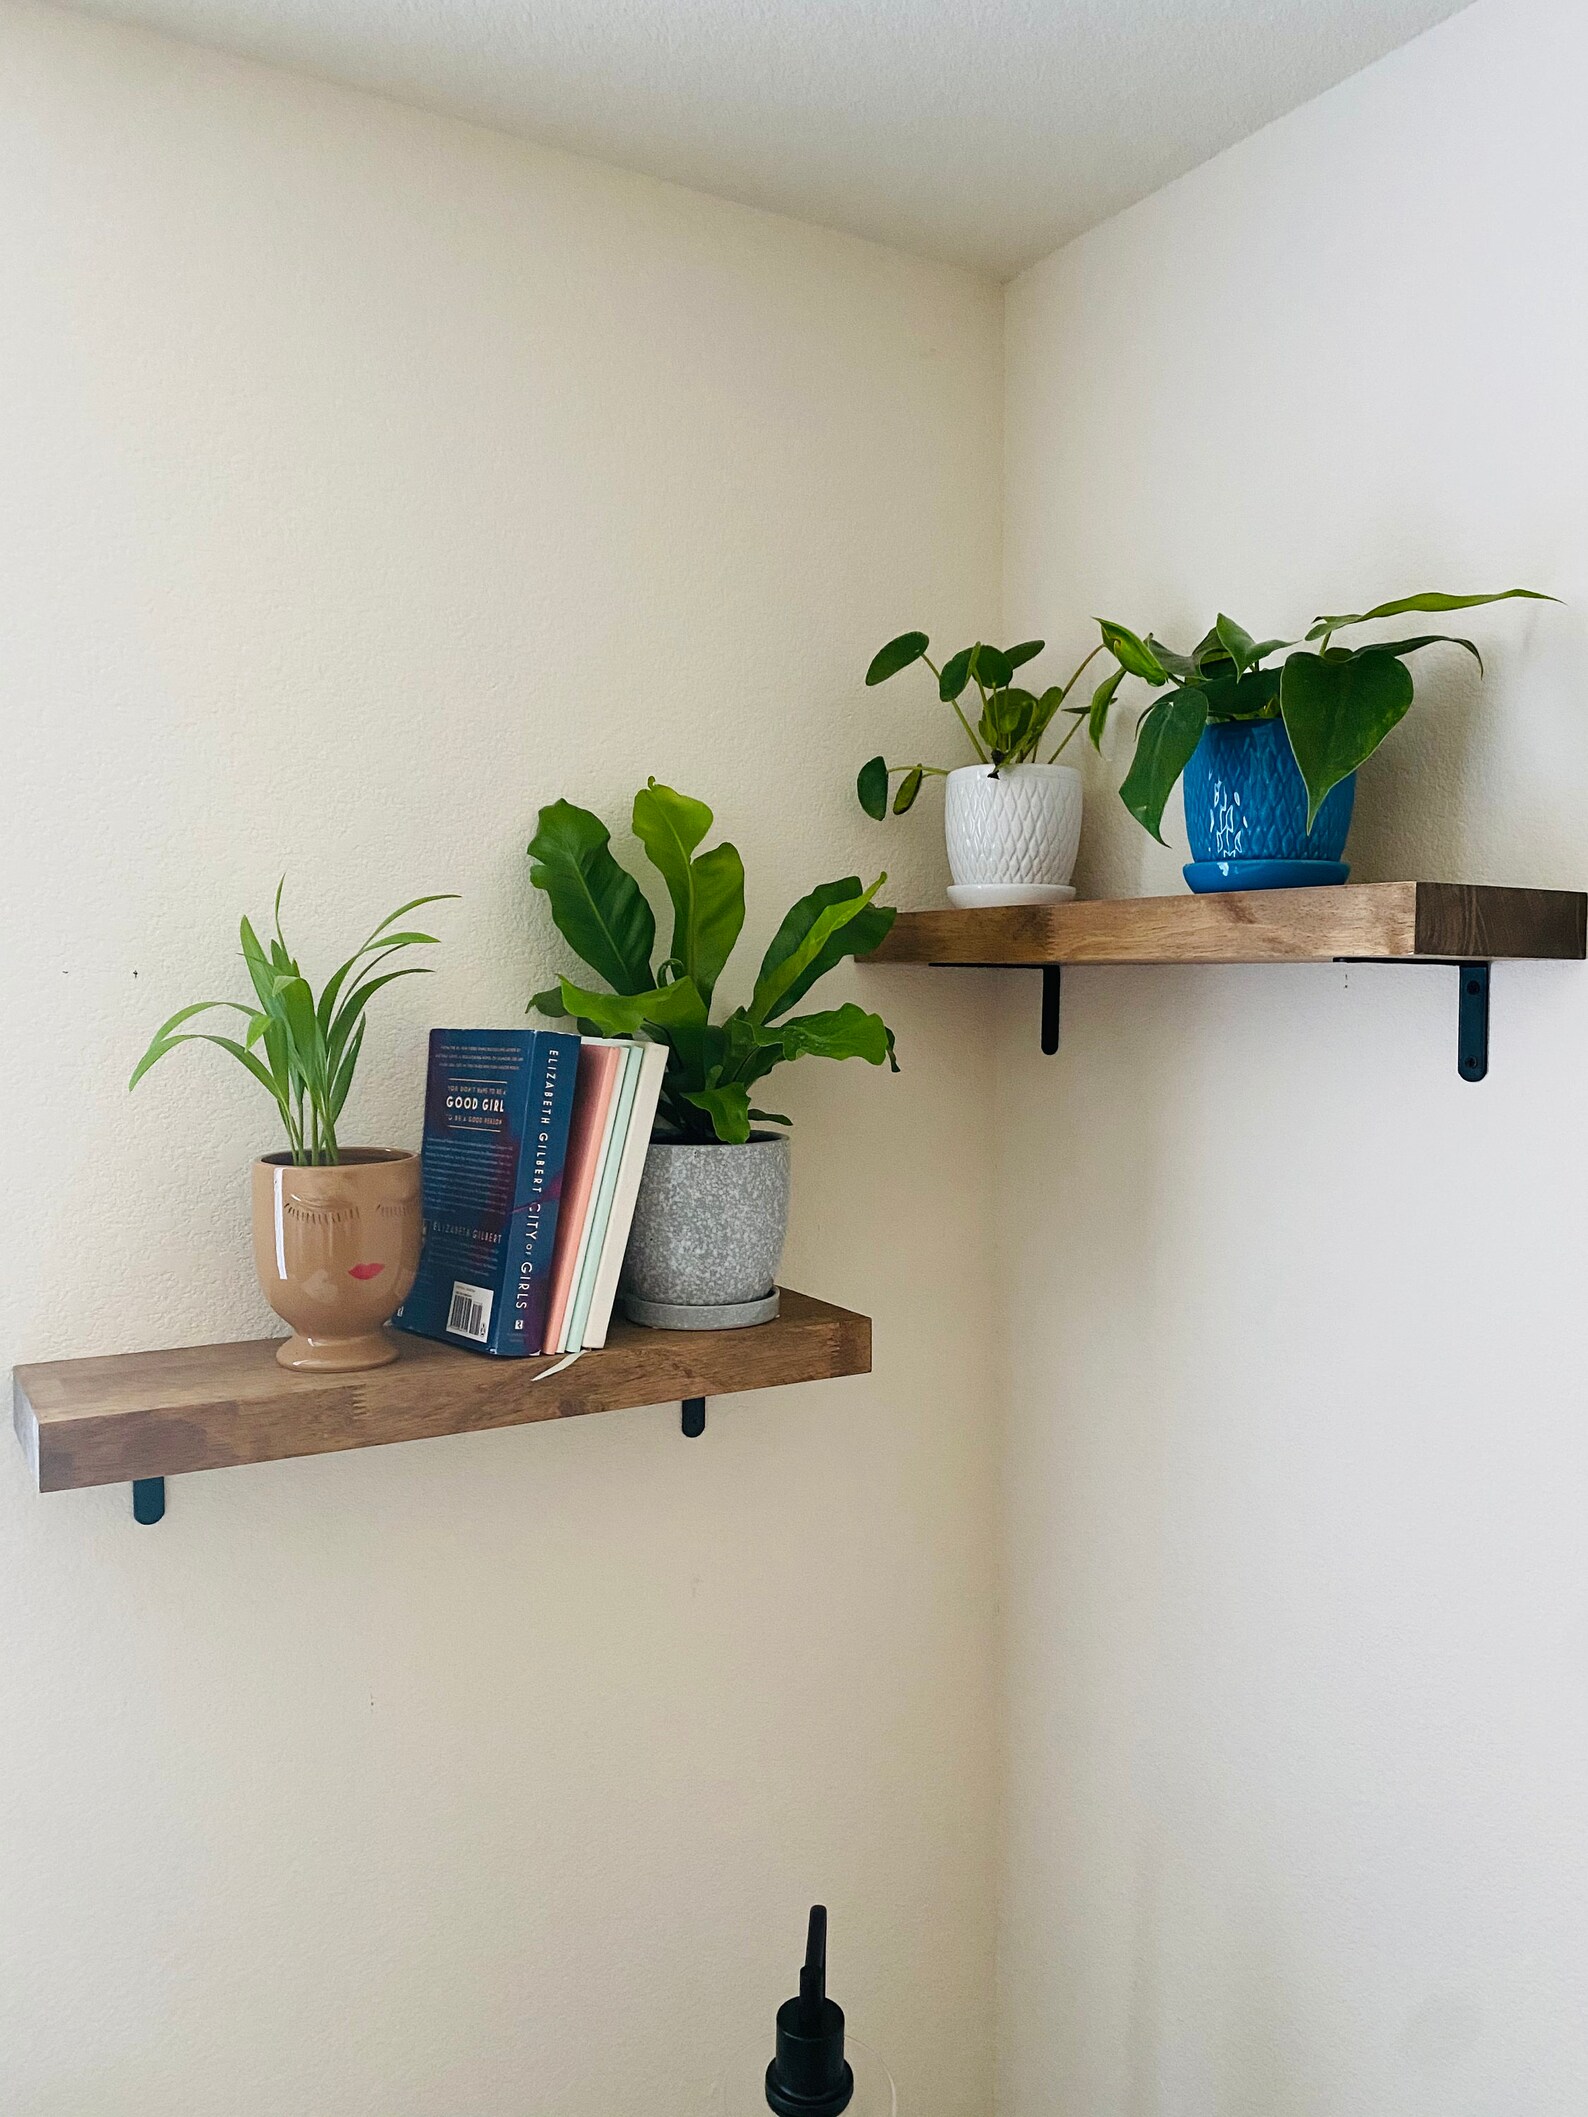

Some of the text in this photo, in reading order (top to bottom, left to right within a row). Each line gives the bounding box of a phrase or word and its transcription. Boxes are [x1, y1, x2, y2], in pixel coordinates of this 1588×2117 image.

[446, 1095, 504, 1113] GOOD GIRL
[532, 1049, 559, 1193] ELIZABETH GILBERT
[472, 1228, 502, 1244] GILBERT
[525, 1203, 541, 1240] CITY
[515, 1261, 533, 1309] GIRLS
